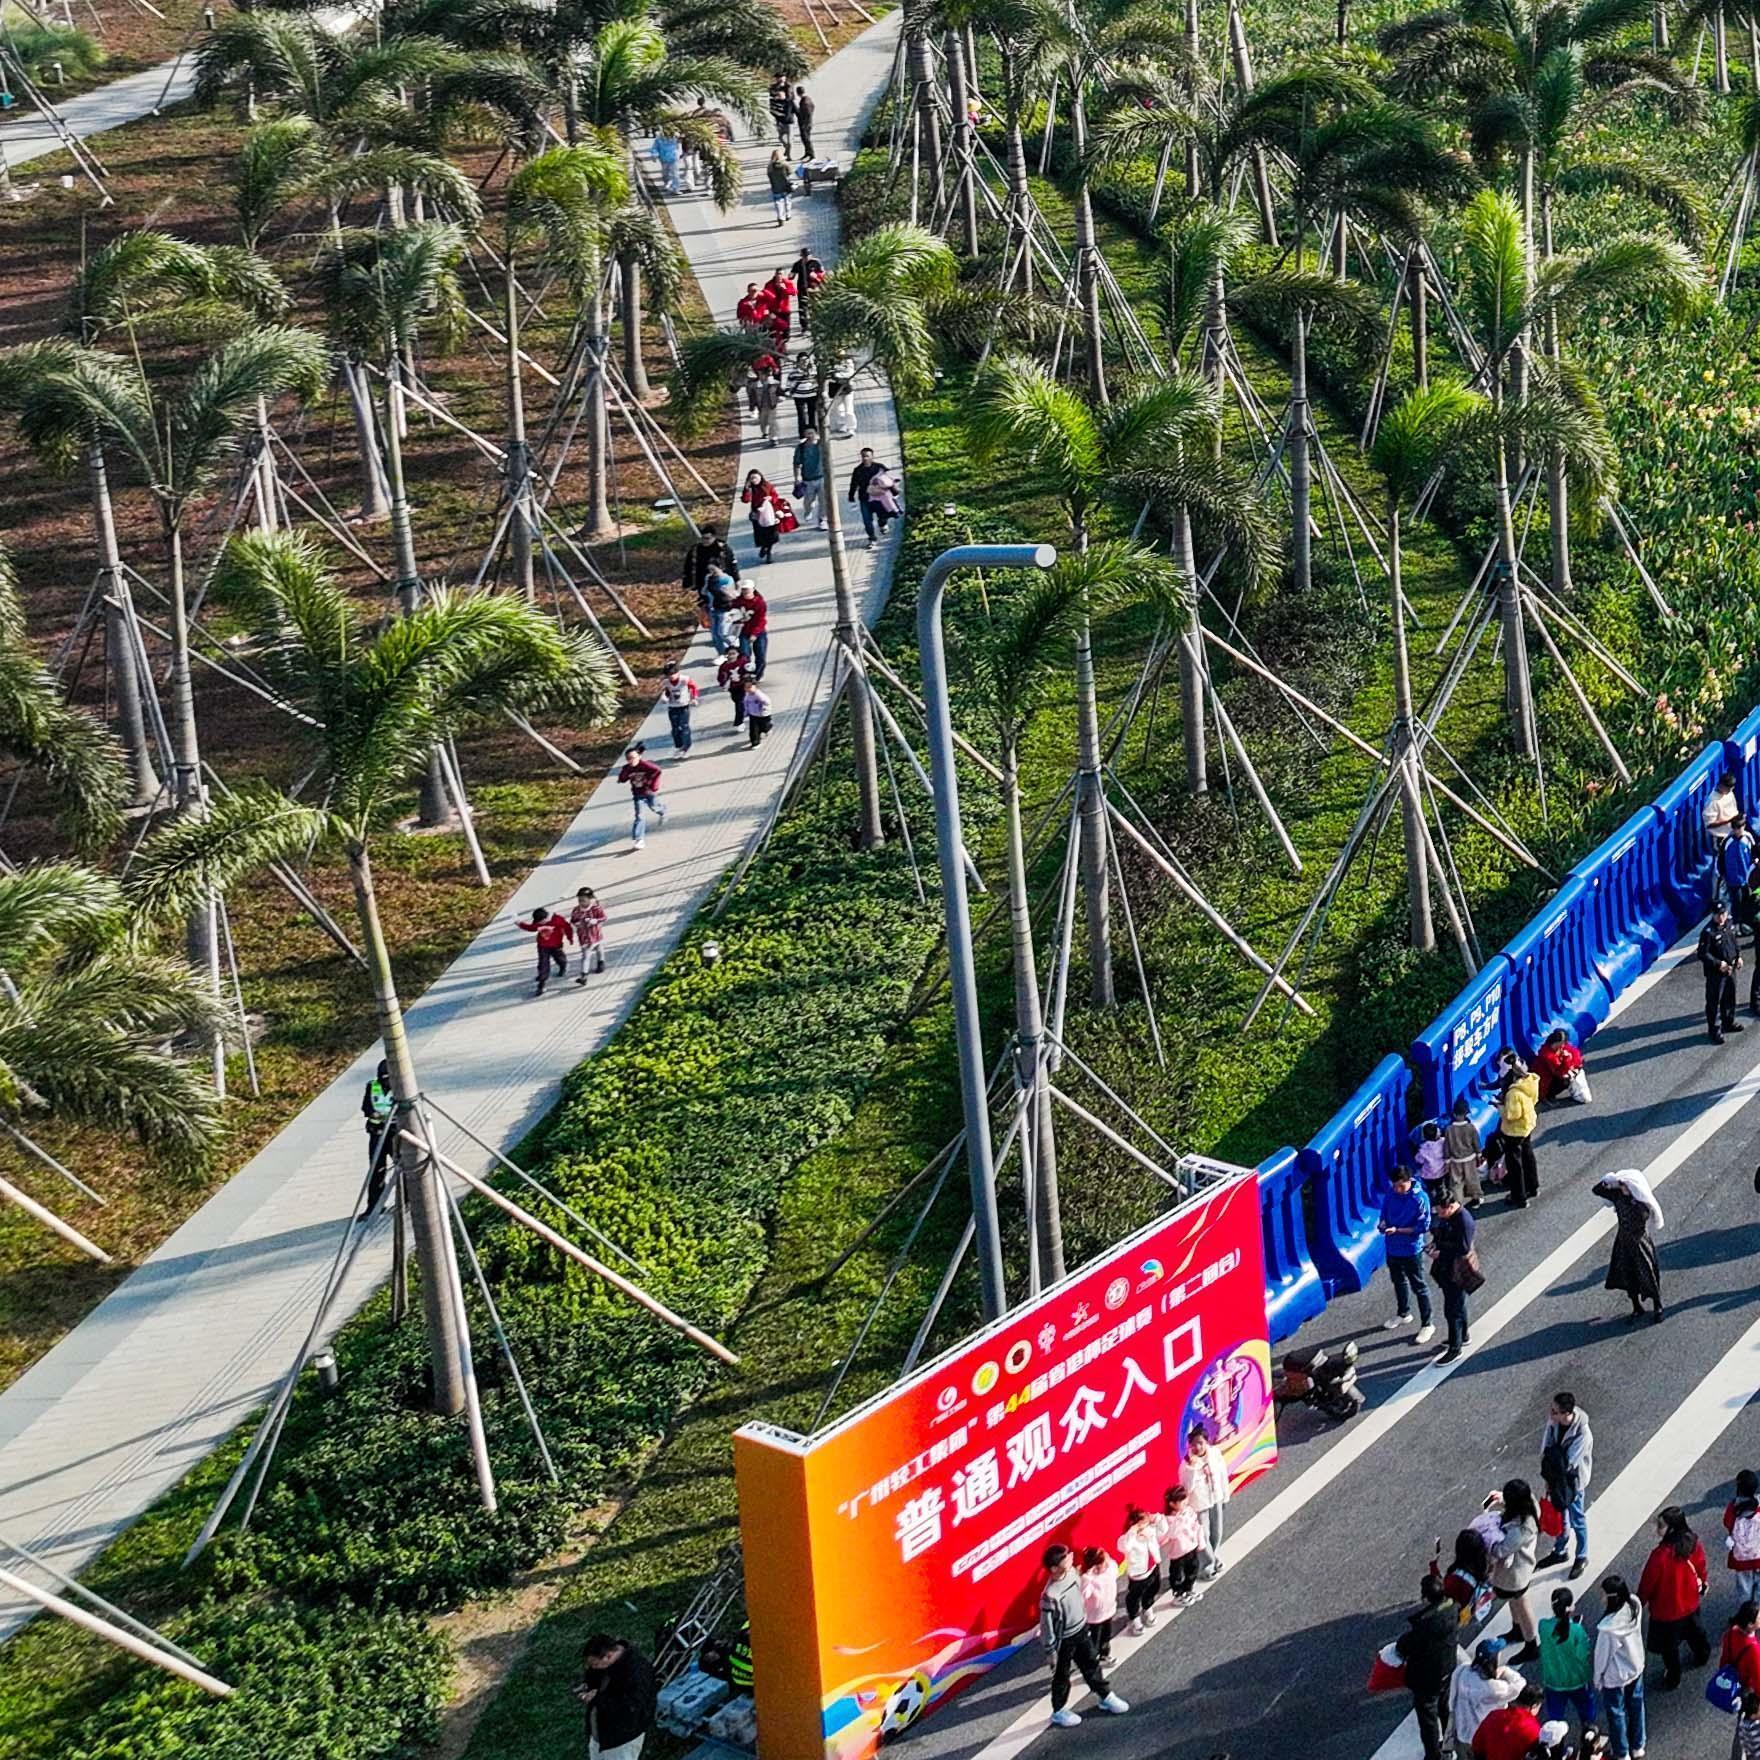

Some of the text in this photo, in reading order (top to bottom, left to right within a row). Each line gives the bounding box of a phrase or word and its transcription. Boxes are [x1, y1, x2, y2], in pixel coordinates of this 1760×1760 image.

[895, 1315, 1203, 1564] 普通观众入口
